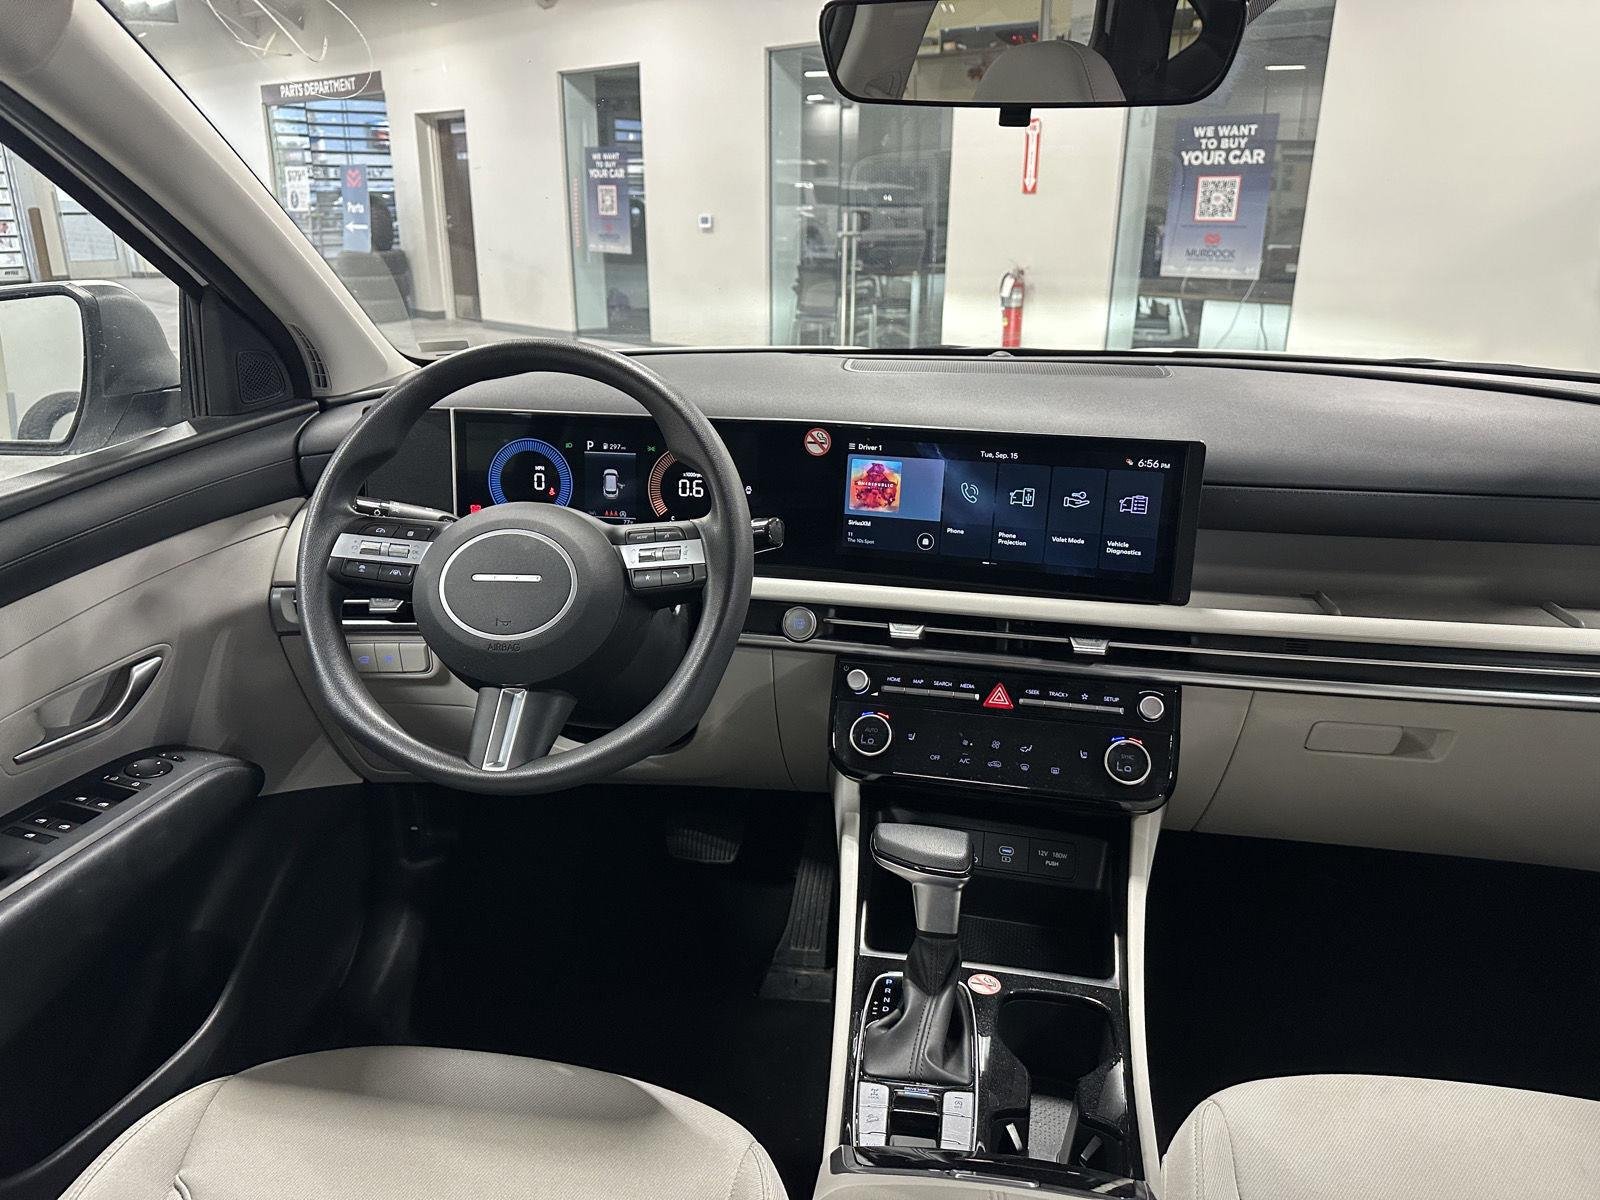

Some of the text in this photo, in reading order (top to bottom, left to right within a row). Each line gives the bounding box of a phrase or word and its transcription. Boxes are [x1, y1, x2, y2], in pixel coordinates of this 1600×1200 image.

[280, 77, 356, 98] PARTS DEPARTMENT
[1193, 124, 1258, 138] WE WANT
[1200, 137, 1248, 149] TO BUY
[1181, 149, 1266, 166] YOUR CAR
[347, 202, 364, 213] Parts
[1185, 248, 1236, 258] MURDOCK
[586, 440, 594, 450] P
[858, 443, 878, 451] Driver
[980, 451, 994, 459] Tue,
[995, 452, 1009, 460] Sep.
[1137, 459, 1160, 469] 6:56
[534, 472, 545, 490] 0
[678, 479, 704, 498] 0.6
[848, 519, 871, 527] SiriusXM
[946, 527, 964, 535] Phone
[997, 539, 1026, 547] Projection
[1068, 537, 1085, 545] Mode
[1107, 541, 1129, 549] Vehicle
[1106, 547, 1141, 557] Diagnostics
[487, 642, 520, 652] AIRBAG
[1037, 849, 1048, 857] 12V
